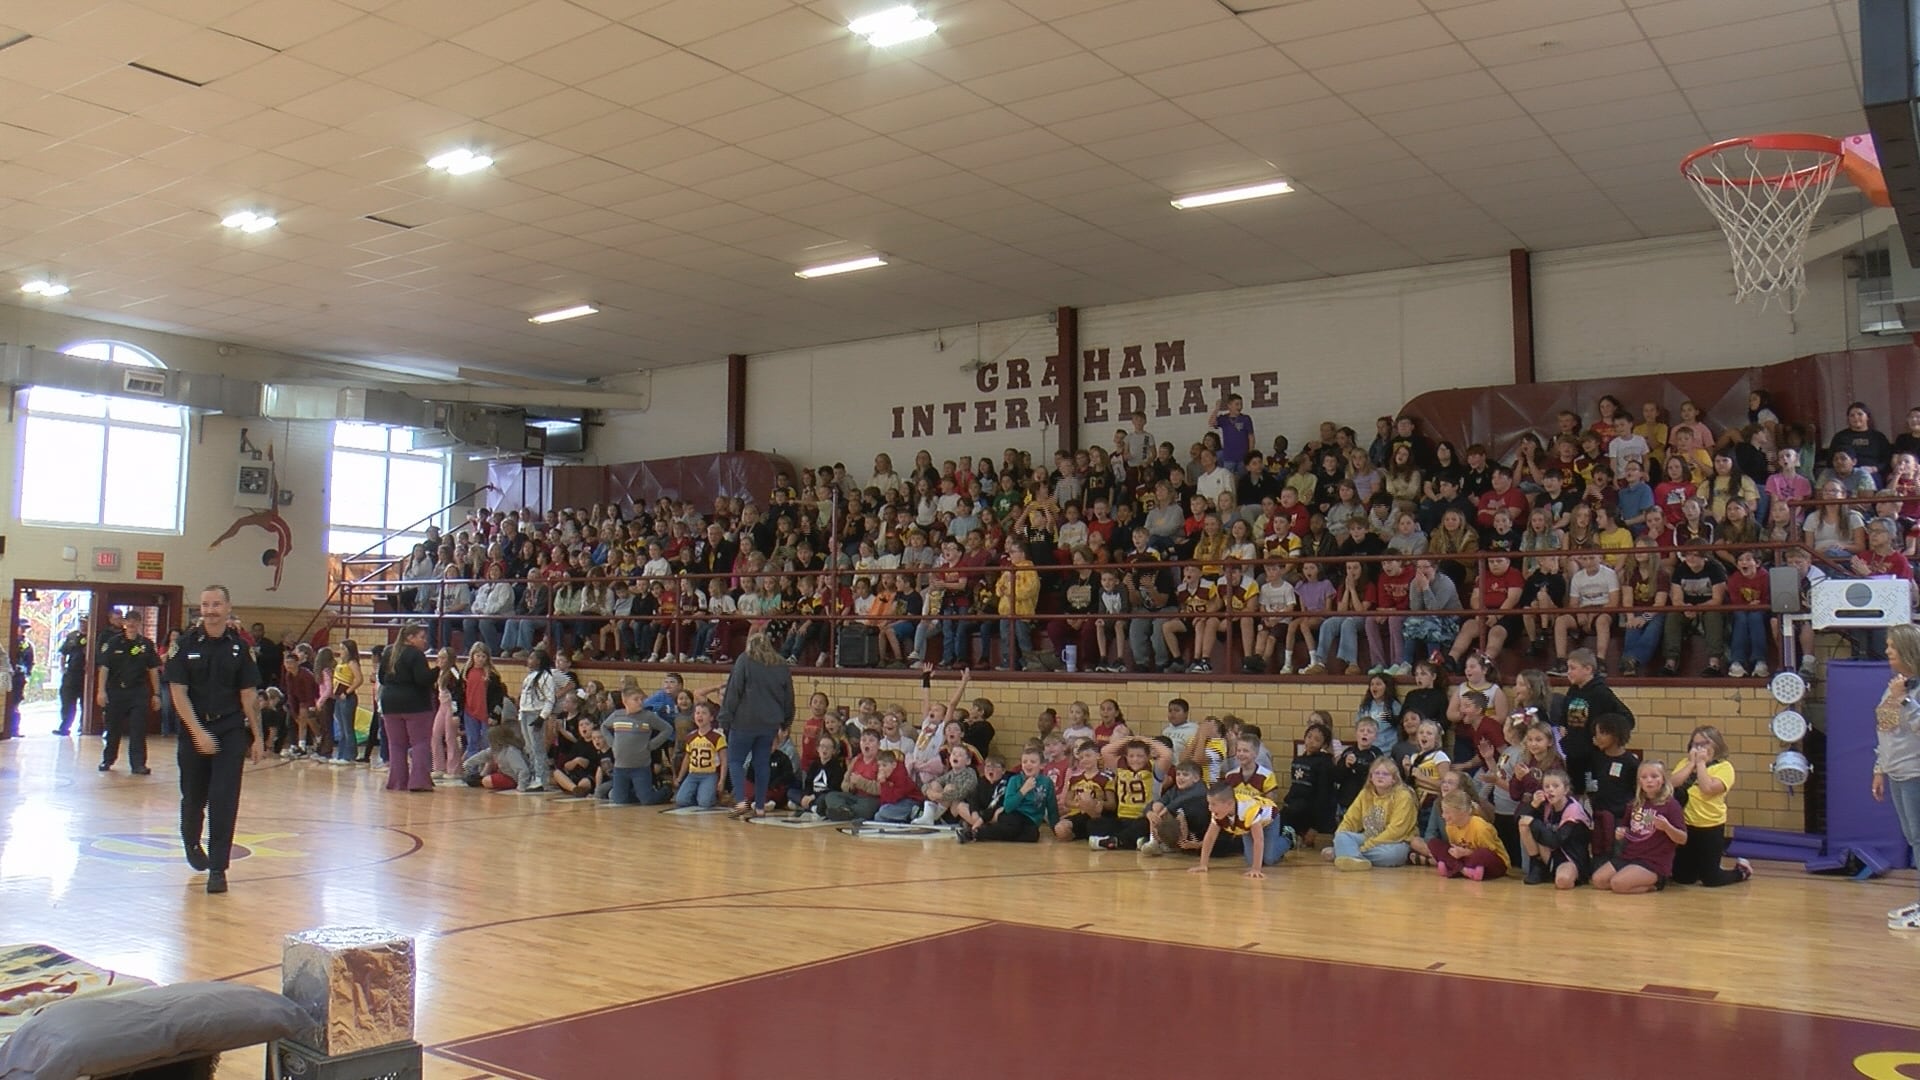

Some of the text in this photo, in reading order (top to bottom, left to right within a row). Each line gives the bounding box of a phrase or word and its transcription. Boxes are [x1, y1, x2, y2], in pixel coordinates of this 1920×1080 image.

[976, 340, 1186, 394] GRAHAM
[891, 371, 1280, 439] INTERMEDIATE
[690, 748, 712, 768] 32
[1118, 779, 1146, 804] 79
